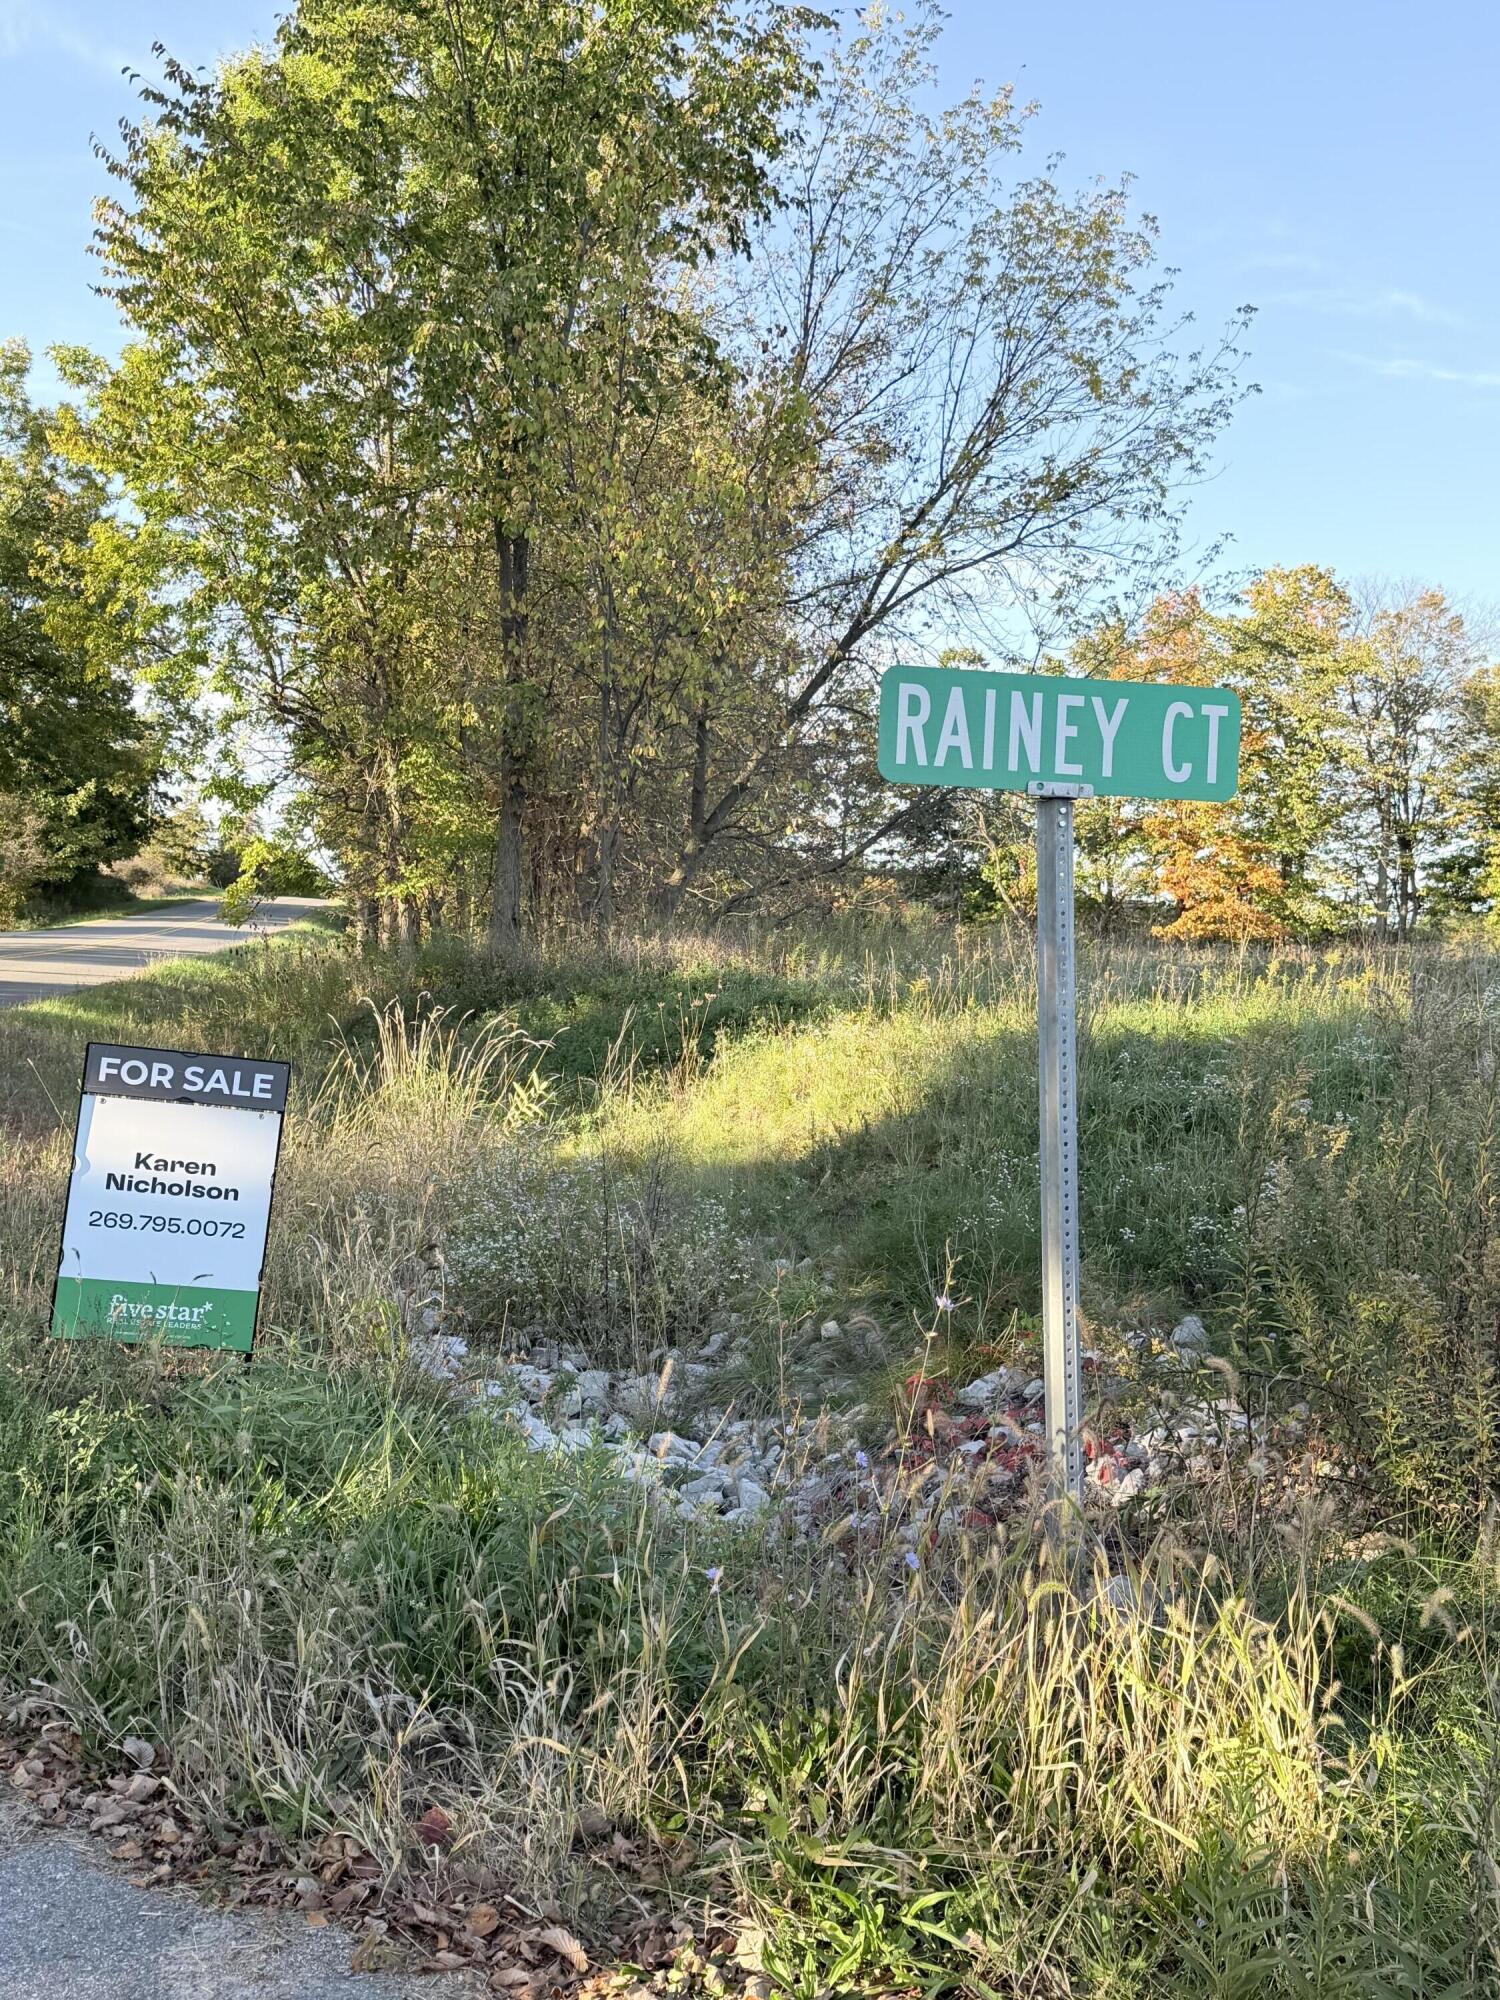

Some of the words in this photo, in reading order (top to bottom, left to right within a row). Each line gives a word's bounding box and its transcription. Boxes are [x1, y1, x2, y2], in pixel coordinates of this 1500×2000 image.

[896, 683, 1130, 778] RAINEY
[1162, 702, 1229, 784] CT
[98, 1056, 174, 1089] FOR
[183, 1066, 274, 1099] SALE
[134, 1152, 217, 1176] Karen
[105, 1173, 239, 1201] Nicholson
[88, 1210, 246, 1239] 269.795.0072
[107, 1294, 153, 1319] five
[106, 1317, 129, 1326] RL
[130, 1318, 162, 1328] ESTE
